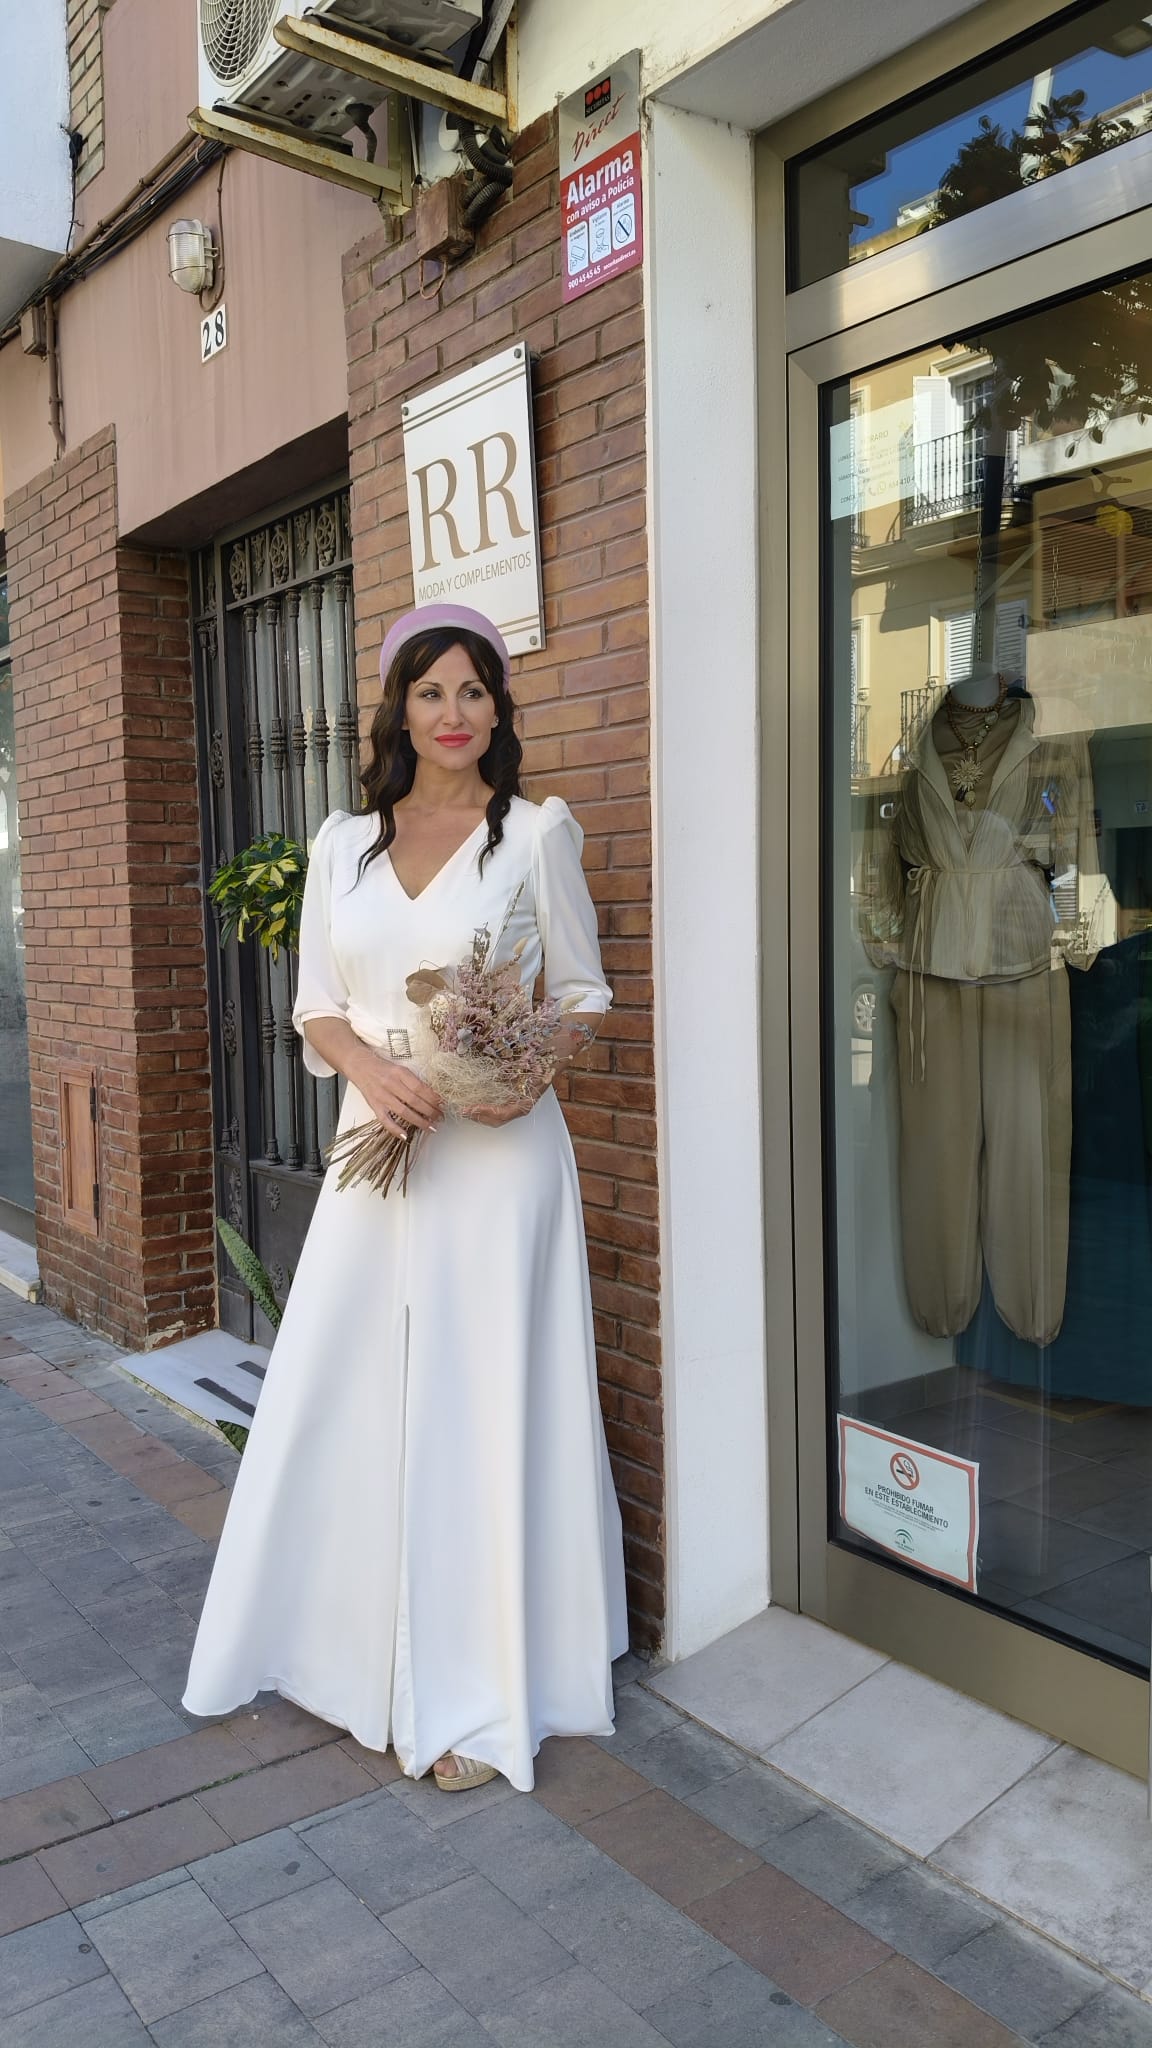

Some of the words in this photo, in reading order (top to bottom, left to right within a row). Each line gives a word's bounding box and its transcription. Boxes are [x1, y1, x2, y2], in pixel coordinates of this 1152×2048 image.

[572, 92, 626, 162] Direct
[566, 150, 634, 209] Alarma
[566, 210, 580, 225] con
[580, 197, 600, 216] aviso
[601, 195, 607, 203] a
[608, 176, 634, 200] Policía
[568, 279, 579, 290] 900
[203, 310, 224, 358] 28
[411, 431, 530, 573] RR
[418, 580, 446, 601] MODA
[446, 578, 453, 592] Y
[454, 551, 532, 590] COMPLEMENTOS
[864, 1486, 874, 1497] EN
[875, 1490, 890, 1503] ESTE
[892, 1498, 949, 1529] ESTABLECIMIENTO
[877, 1484, 910, 1504] PROHIBIDO
[912, 1498, 934, 1514] FUMAR
